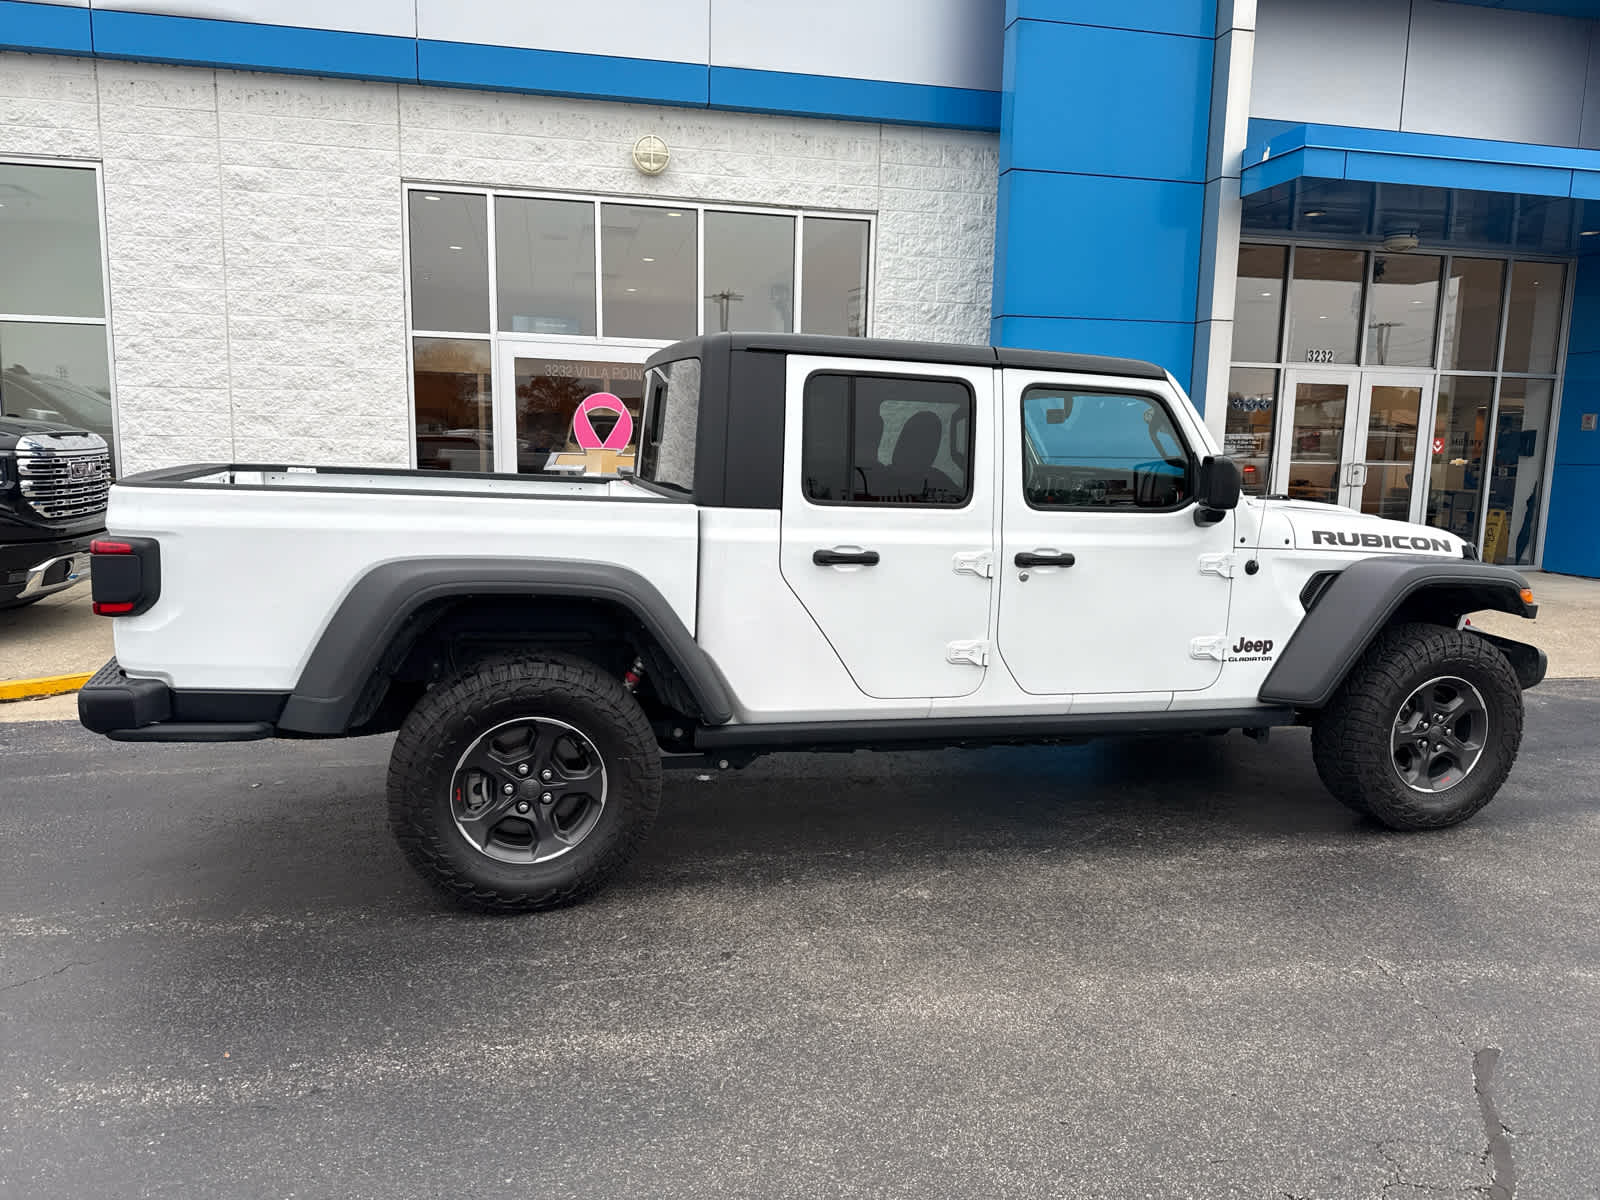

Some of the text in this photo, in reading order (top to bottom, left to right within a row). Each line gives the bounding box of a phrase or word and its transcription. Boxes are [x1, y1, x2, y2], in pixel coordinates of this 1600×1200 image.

[1308, 350, 1333, 363] 3232
[544, 364, 644, 380] 3232 VILLA POIN
[1311, 530, 1452, 552] RUBICON
[1232, 636, 1274, 655] Jeep
